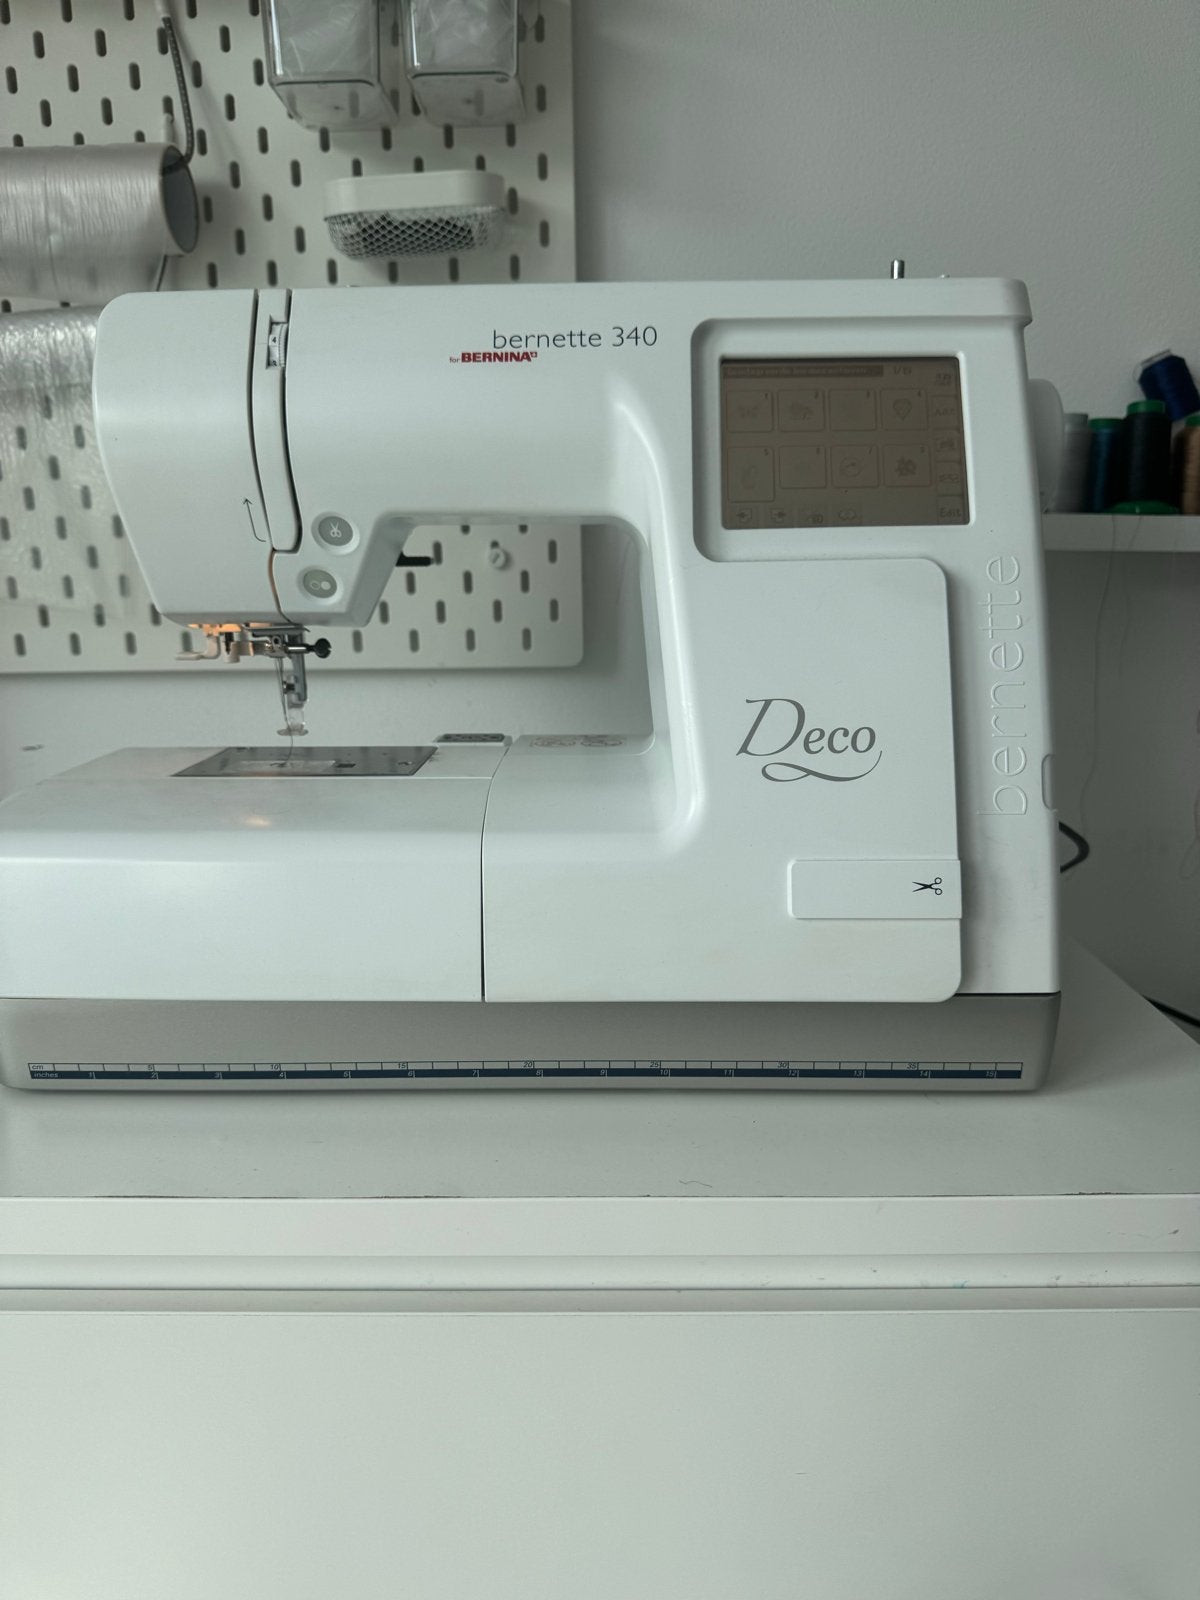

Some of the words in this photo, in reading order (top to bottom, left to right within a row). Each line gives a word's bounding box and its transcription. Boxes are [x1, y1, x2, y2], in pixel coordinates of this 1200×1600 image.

[493, 330, 602, 349] bernette
[612, 326, 658, 347] 340
[461, 352, 532, 363] BERNINA
[939, 504, 962, 518] Edit
[976, 556, 1027, 815] bernette
[736, 698, 876, 756] Deco
